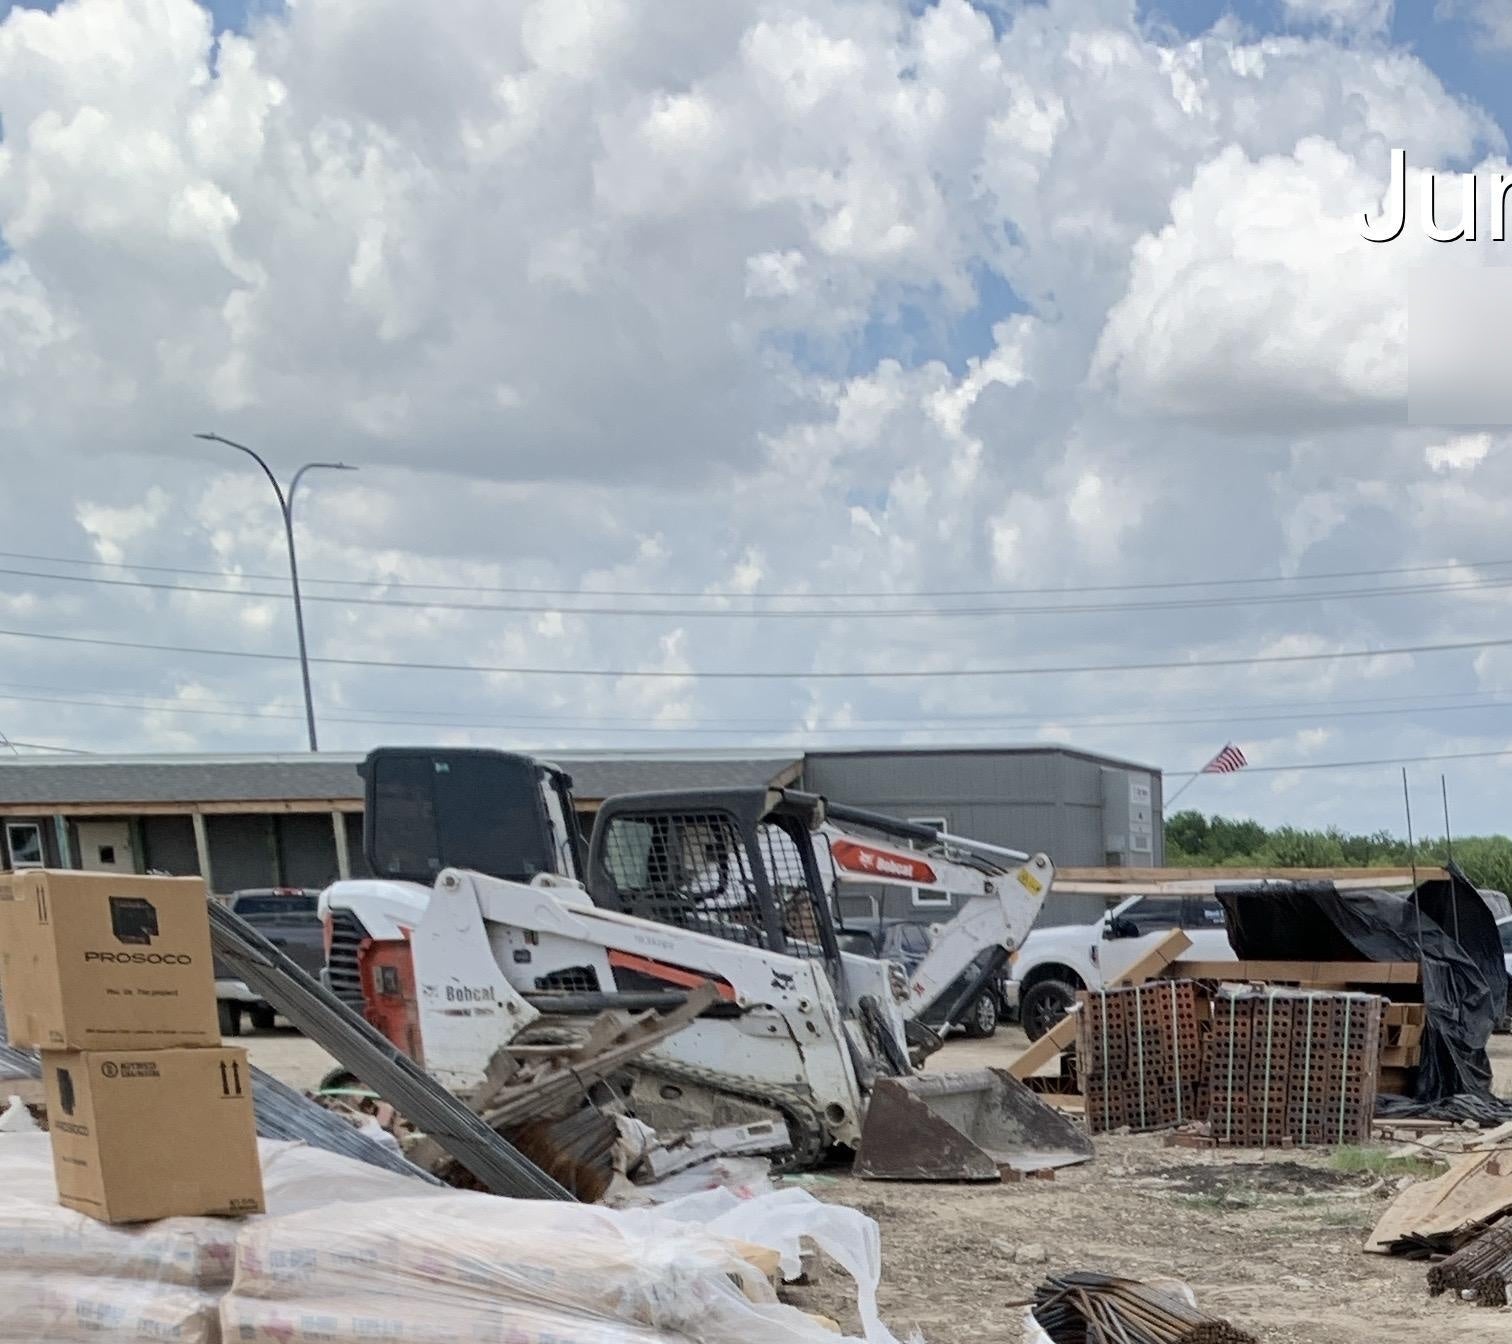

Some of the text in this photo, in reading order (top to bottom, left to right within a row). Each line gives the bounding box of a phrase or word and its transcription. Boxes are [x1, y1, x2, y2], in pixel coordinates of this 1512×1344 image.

[875, 855, 914, 878] Bobcat
[84, 951, 192, 965] PROSOCO
[446, 984, 495, 1002] Bobcat
